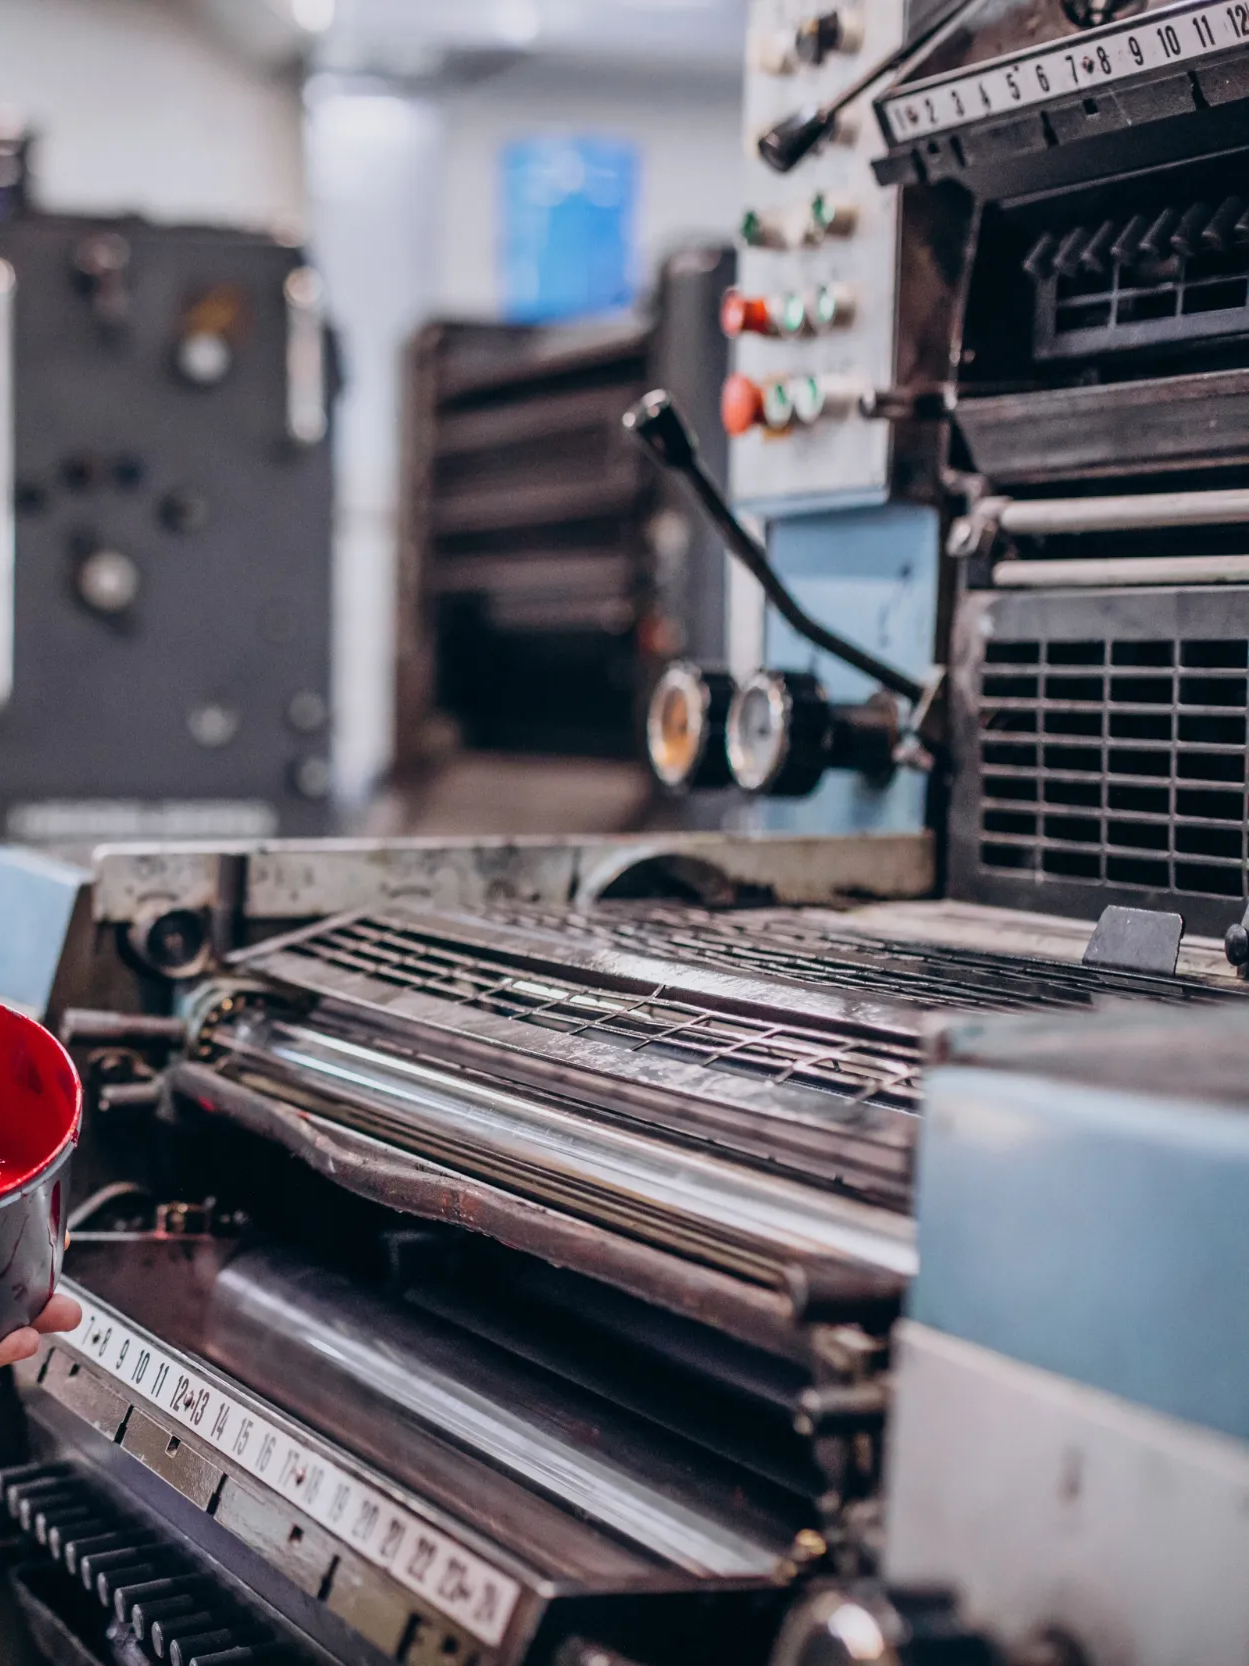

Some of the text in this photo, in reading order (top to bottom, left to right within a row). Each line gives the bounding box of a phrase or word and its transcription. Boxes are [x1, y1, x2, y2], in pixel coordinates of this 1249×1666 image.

[1006, 73, 1021, 100] 5
[1036, 65, 1050, 92] 6
[1066, 55, 1079, 83] 7
[1097, 47, 1111, 75] 8
[1129, 36, 1144, 66] 9
[1157, 26, 1181, 58] 10
[1193, 15, 1215, 49] 11
[1227, 4, 1249, 38] 12
[81, 1315, 96, 1346] 7
[99, 1327, 112, 1357] 8
[116, 1339, 130, 1370] 9
[131, 1349, 151, 1384] 10
[151, 1362, 170, 1398] 11
[169, 1375, 189, 1411] 12
[190, 1388, 210, 1426] 13
[210, 1402, 231, 1441] 14
[232, 1417, 254, 1456] 15
[254, 1433, 277, 1473] 16
